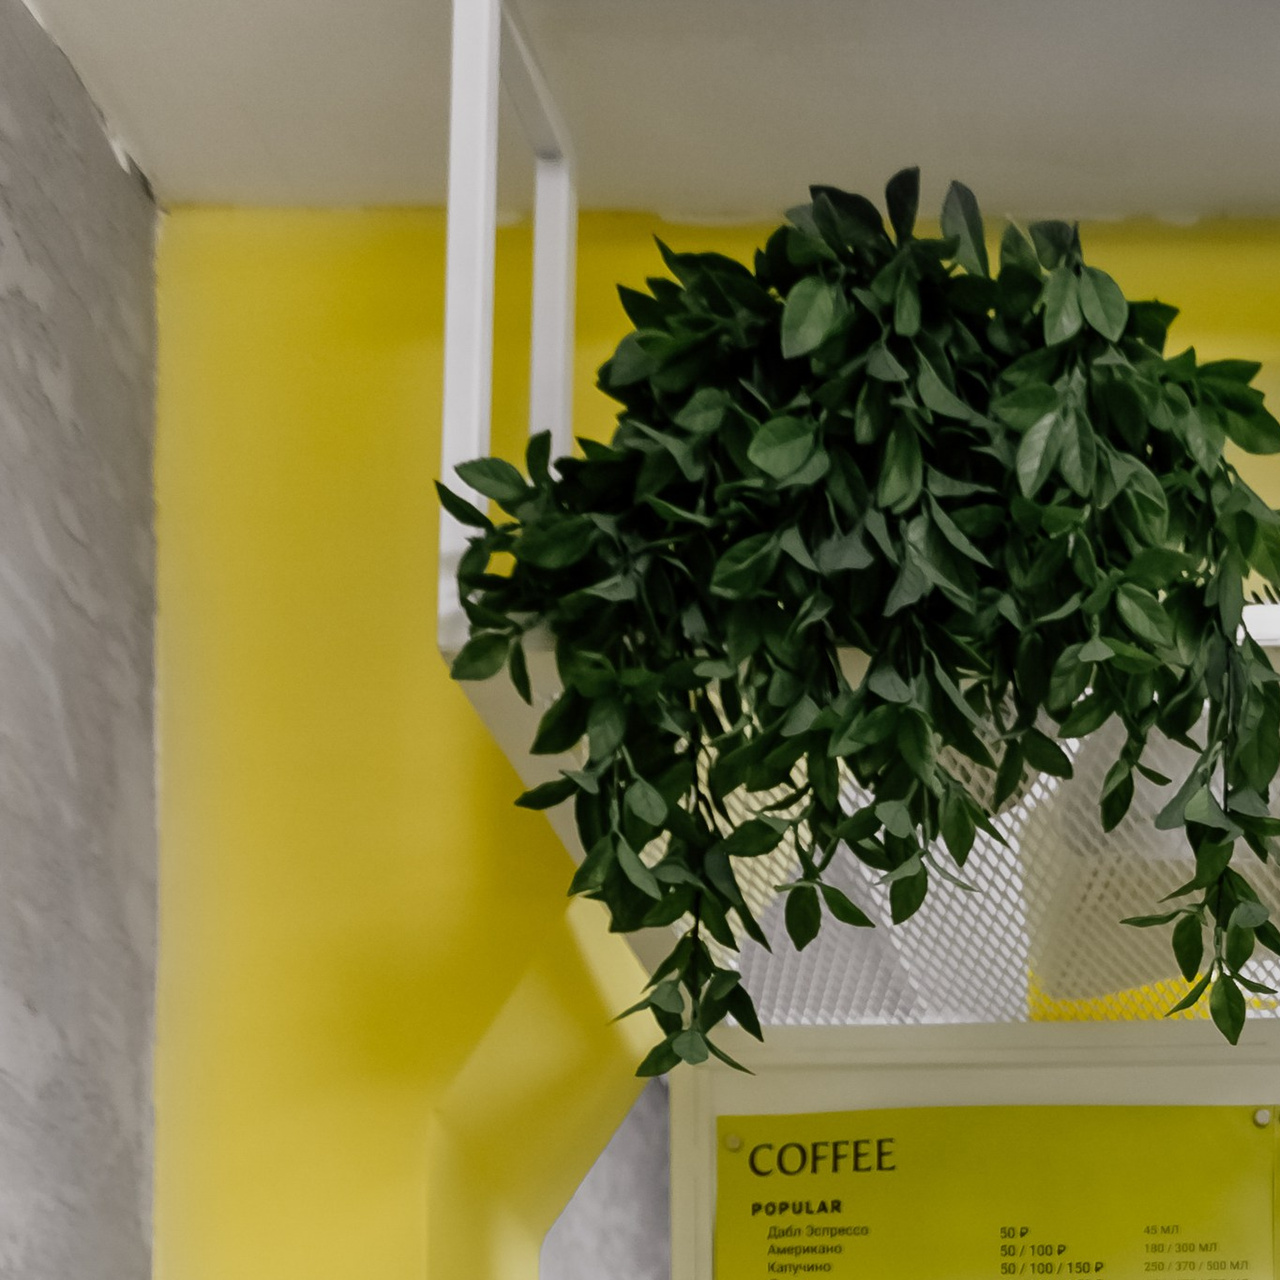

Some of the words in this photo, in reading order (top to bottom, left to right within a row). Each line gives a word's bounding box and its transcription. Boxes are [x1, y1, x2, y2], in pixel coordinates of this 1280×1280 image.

[748, 1137, 896, 1177] COFFEE
[751, 1199, 842, 1217] POPULAR
[766, 1224, 802, 1241] Дабл
[805, 1224, 870, 1239] Эспрессо
[1000, 1226, 1016, 1240] 50
[767, 1243, 843, 1258] Американо
[1000, 1244, 1017, 1258] 50
[1029, 1244, 1054, 1257] 100
[767, 1261, 832, 1276] Капучино
[1000, 1261, 1017, 1275] 50
[1029, 1261, 1054, 1275] 100
[1066, 1261, 1091, 1274] 150
